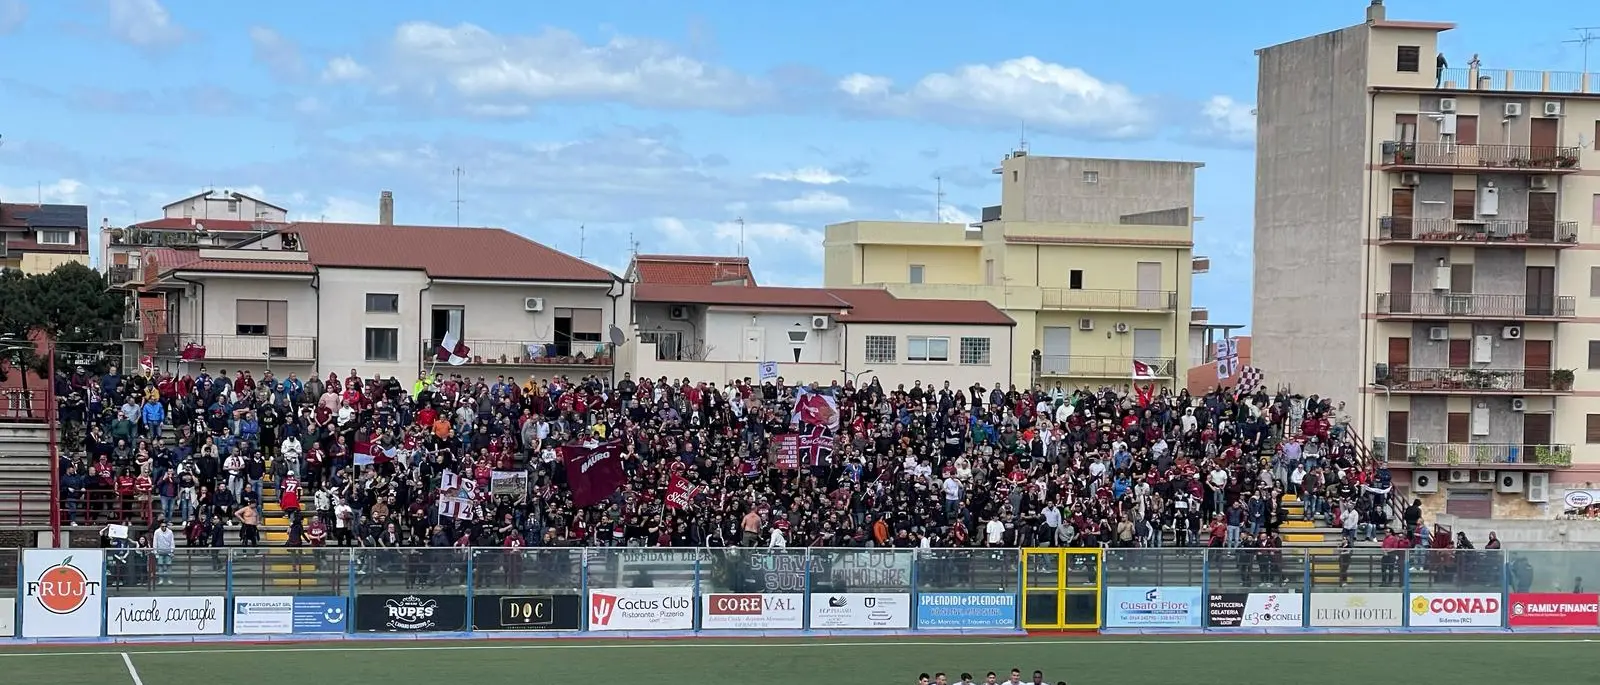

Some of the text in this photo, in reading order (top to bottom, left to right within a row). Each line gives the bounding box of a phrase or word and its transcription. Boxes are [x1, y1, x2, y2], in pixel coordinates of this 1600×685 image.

[624, 552, 674, 563] DIFFIDATI
[751, 553, 825, 573] CURVA
[765, 572, 806, 590] SUD
[617, 596, 689, 610] Cactus Club
[921, 595, 1013, 606] SPLENDIDI e SPLENDENTI
[1430, 598, 1500, 614] CONAD
[388, 606, 434, 618] RUPES
[1317, 608, 1395, 620] EURO HOTEL
[1527, 603, 1599, 613] FAMILY FINANCE
[114, 598, 217, 632] piccole canaglie
